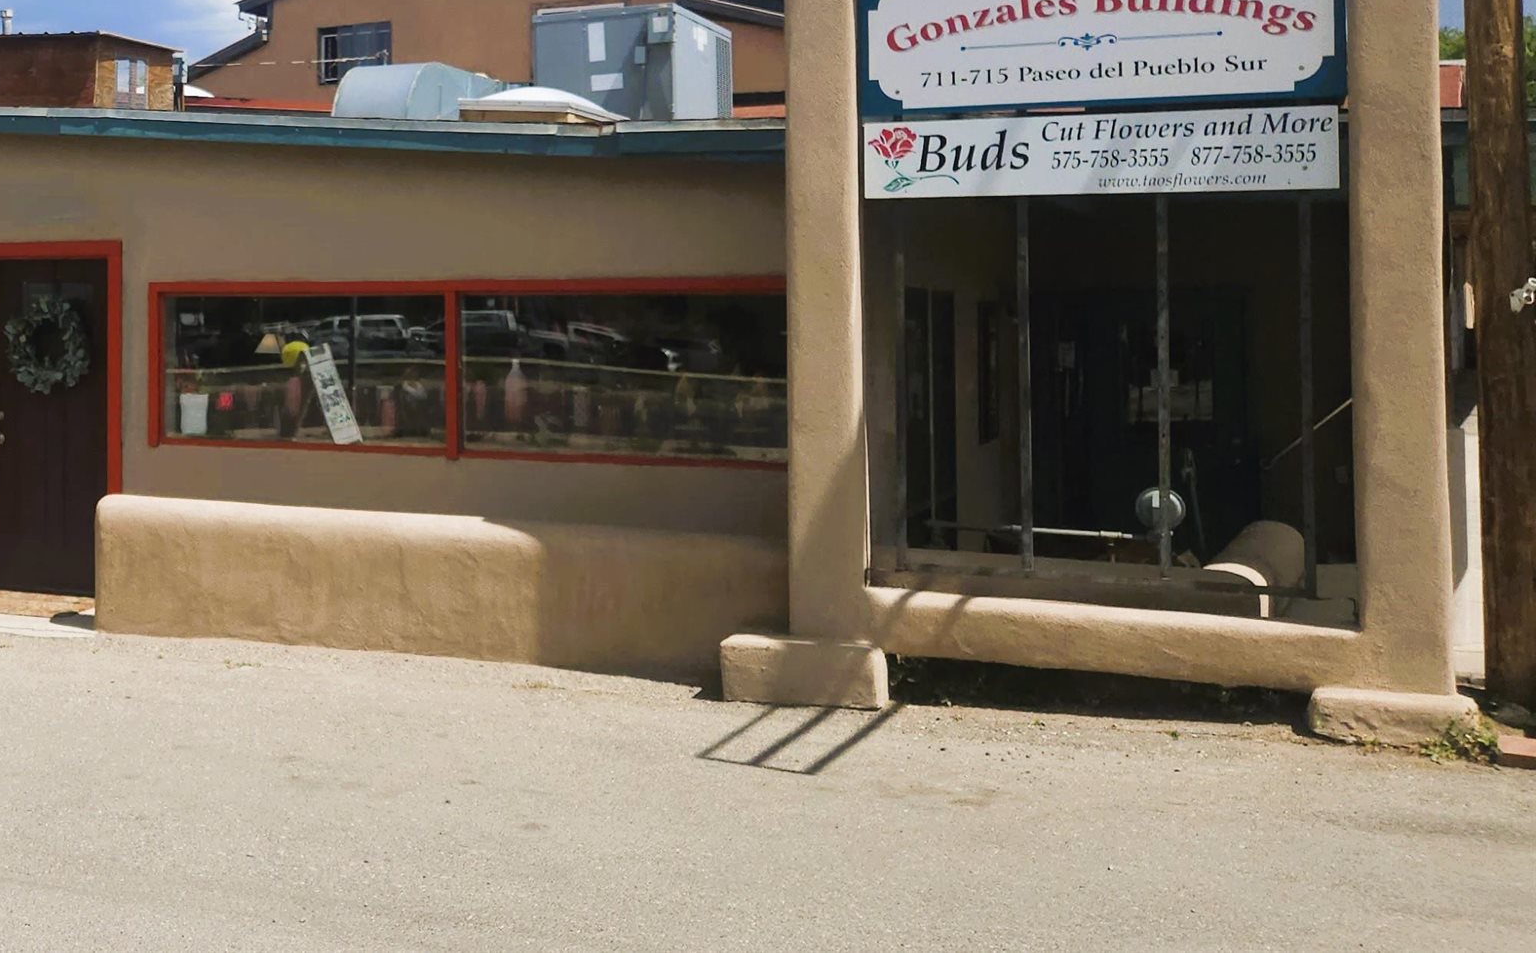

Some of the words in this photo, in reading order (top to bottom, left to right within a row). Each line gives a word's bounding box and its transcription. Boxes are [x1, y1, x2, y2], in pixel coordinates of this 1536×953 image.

[921, 66, 1009, 88] 711-715
[1019, 63, 1081, 83] Paseo
[1089, 61, 1124, 79] del
[1133, 57, 1215, 77] Pueblo
[1223, 54, 1268, 73] Sur
[1042, 120, 1086, 143] Cut
[1092, 117, 1195, 141] Flowers
[1204, 113, 1253, 136] and
[1261, 111, 1333, 135] More
[916, 129, 1031, 174] Buds
[1051, 147, 1169, 170] 575-758-3555
[1190, 143, 1317, 166] 877-758-3555
[1097, 171, 1267, 191] www.taosflowers.com
